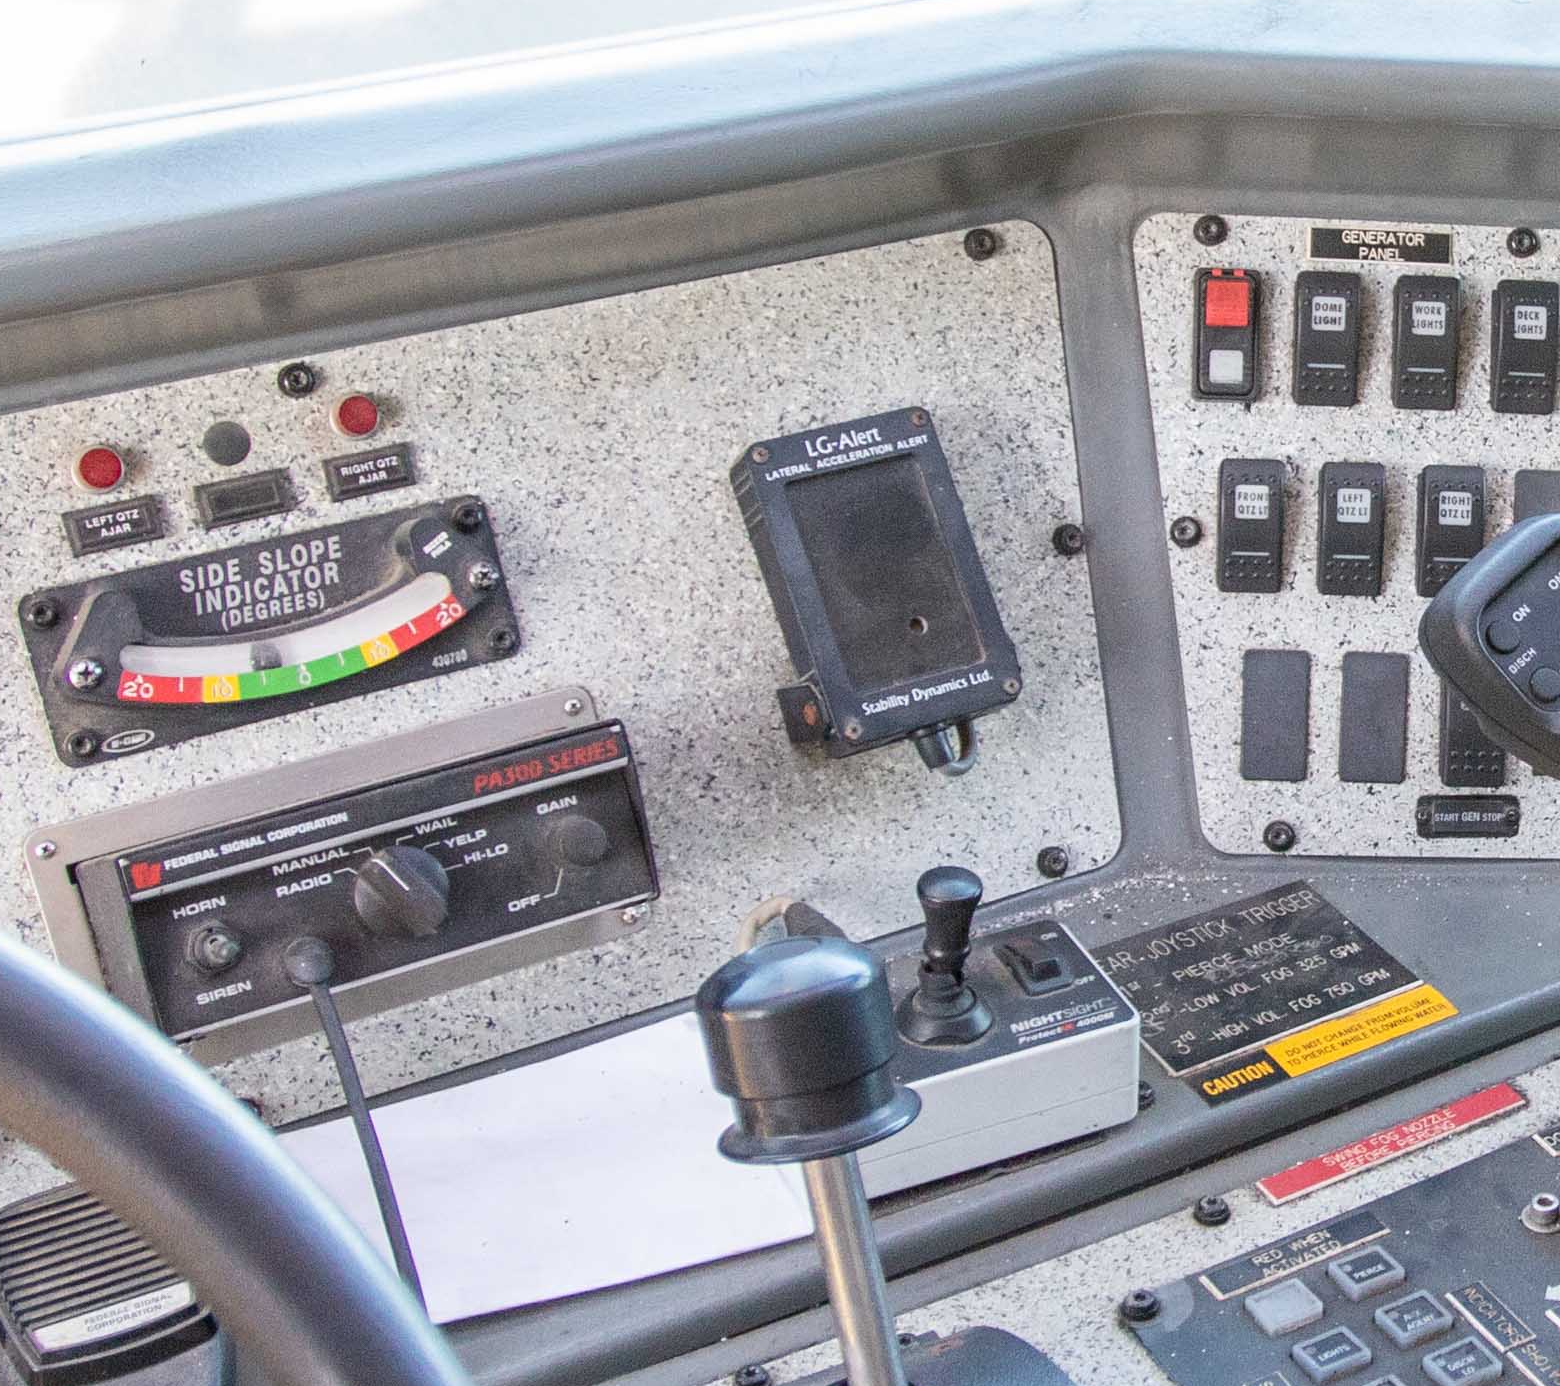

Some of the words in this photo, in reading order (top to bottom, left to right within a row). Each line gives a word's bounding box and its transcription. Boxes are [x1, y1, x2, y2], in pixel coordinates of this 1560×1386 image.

[1342, 231, 1425, 246] GENERATOR
[1359, 247, 1403, 261] PANEL
[1416, 305, 1443, 316] WORK
[1517, 311, 1540, 322] DECK
[765, 461, 811, 481] LATERAL
[816, 444, 894, 471] ACCELERATION
[897, 433, 929, 450] ALERT
[804, 427, 882, 457] LG-Alert
[340, 462, 374, 477] RIGHT
[376, 456, 398, 471] QTZ
[358, 470, 388, 485] AJAR
[1342, 493, 1364, 504] LEFT
[1440, 496, 1471, 508] RIGHT
[1440, 508, 1459, 519] QTZ
[1461, 509, 1471, 519] LT
[84, 515, 113, 530] LEFT
[115, 508, 141, 524] QTZ
[100, 523, 131, 537] AJAR
[180, 561, 241, 594] SIDE
[259, 537, 342, 575] SLOPE
[194, 564, 340, 615] INDICATOR
[220, 589, 325, 632] (DEGREES)
[1512, 604, 1531, 622] ON
[122, 682, 154, 698] 20
[436, 605, 463, 628] 20
[1509, 647, 1537, 674] DISCH
[862, 692, 909, 716] Stability
[912, 678, 968, 702] Dynamics
[969, 670, 993, 686] Ltd.
[473, 764, 542, 794] PA300
[548, 739, 618, 772] SERIES
[536, 796, 577, 814] GAIN
[1435, 812, 1460, 823] START
[1461, 811, 1480, 823] GEN
[163, 849, 218, 871] FEDERAL
[220, 835, 263, 857] SIGNAL
[266, 812, 348, 843] CORPORATION
[415, 817, 457, 836] WAIL
[443, 829, 487, 849] YELP
[272, 846, 349, 876] MANUAL
[464, 843, 509, 865] HI-LO
[275, 873, 333, 898] RADIO
[172, 895, 227, 920] HORN
[507, 894, 541, 913] OFF
[1145, 919, 1235, 960] JOYSTICK
[1238, 889, 1321, 928] TRIGGER
[1172, 953, 1239, 981] PIERCE
[1244, 933, 1298, 958] MODE
[1299, 955, 1327, 973] 325
[1330, 941, 1362, 961] GPM
[196, 981, 252, 1006] SIREN
[1288, 993, 1322, 1013] FOG
[1323, 981, 1355, 1000] 750
[1359, 968, 1391, 987] GPM
[1010, 1000, 1105, 1034] NIGHTSIGHT
[1285, 1045, 1300, 1057] DO
[1302, 1037, 1322, 1051] NOT
[1325, 1023, 1363, 1043] CHANGE
[1365, 1012, 1394, 1029] FROM
[1393, 997, 1433, 1016] VOLUME
[1287, 1056, 1301, 1067] TO
[1303, 1044, 1338, 1062] PIERCE
[1340, 1032, 1370, 1049] WHILE
[1371, 1014, 1414, 1036] FLOWING
[1415, 1002, 1447, 1019] WATER
[1202, 1060, 1275, 1096] CAUTION
[1322, 1142, 1369, 1167] SWING
[1370, 1131, 1400, 1151] FOG
[1401, 1108, 1457, 1135] NOZZLE
[1342, 1145, 1391, 1171] BEFORE
[1397, 1120, 1457, 1149] PIERCING
[1252, 1247, 1281, 1266] RED
[1287, 1228, 1331, 1252] WHEN
[1261, 1241, 1341, 1277] ACTIVATED
[86, 1303, 165, 1334] CORPORATION
[1464, 1286, 1527, 1344] INDICATORS
